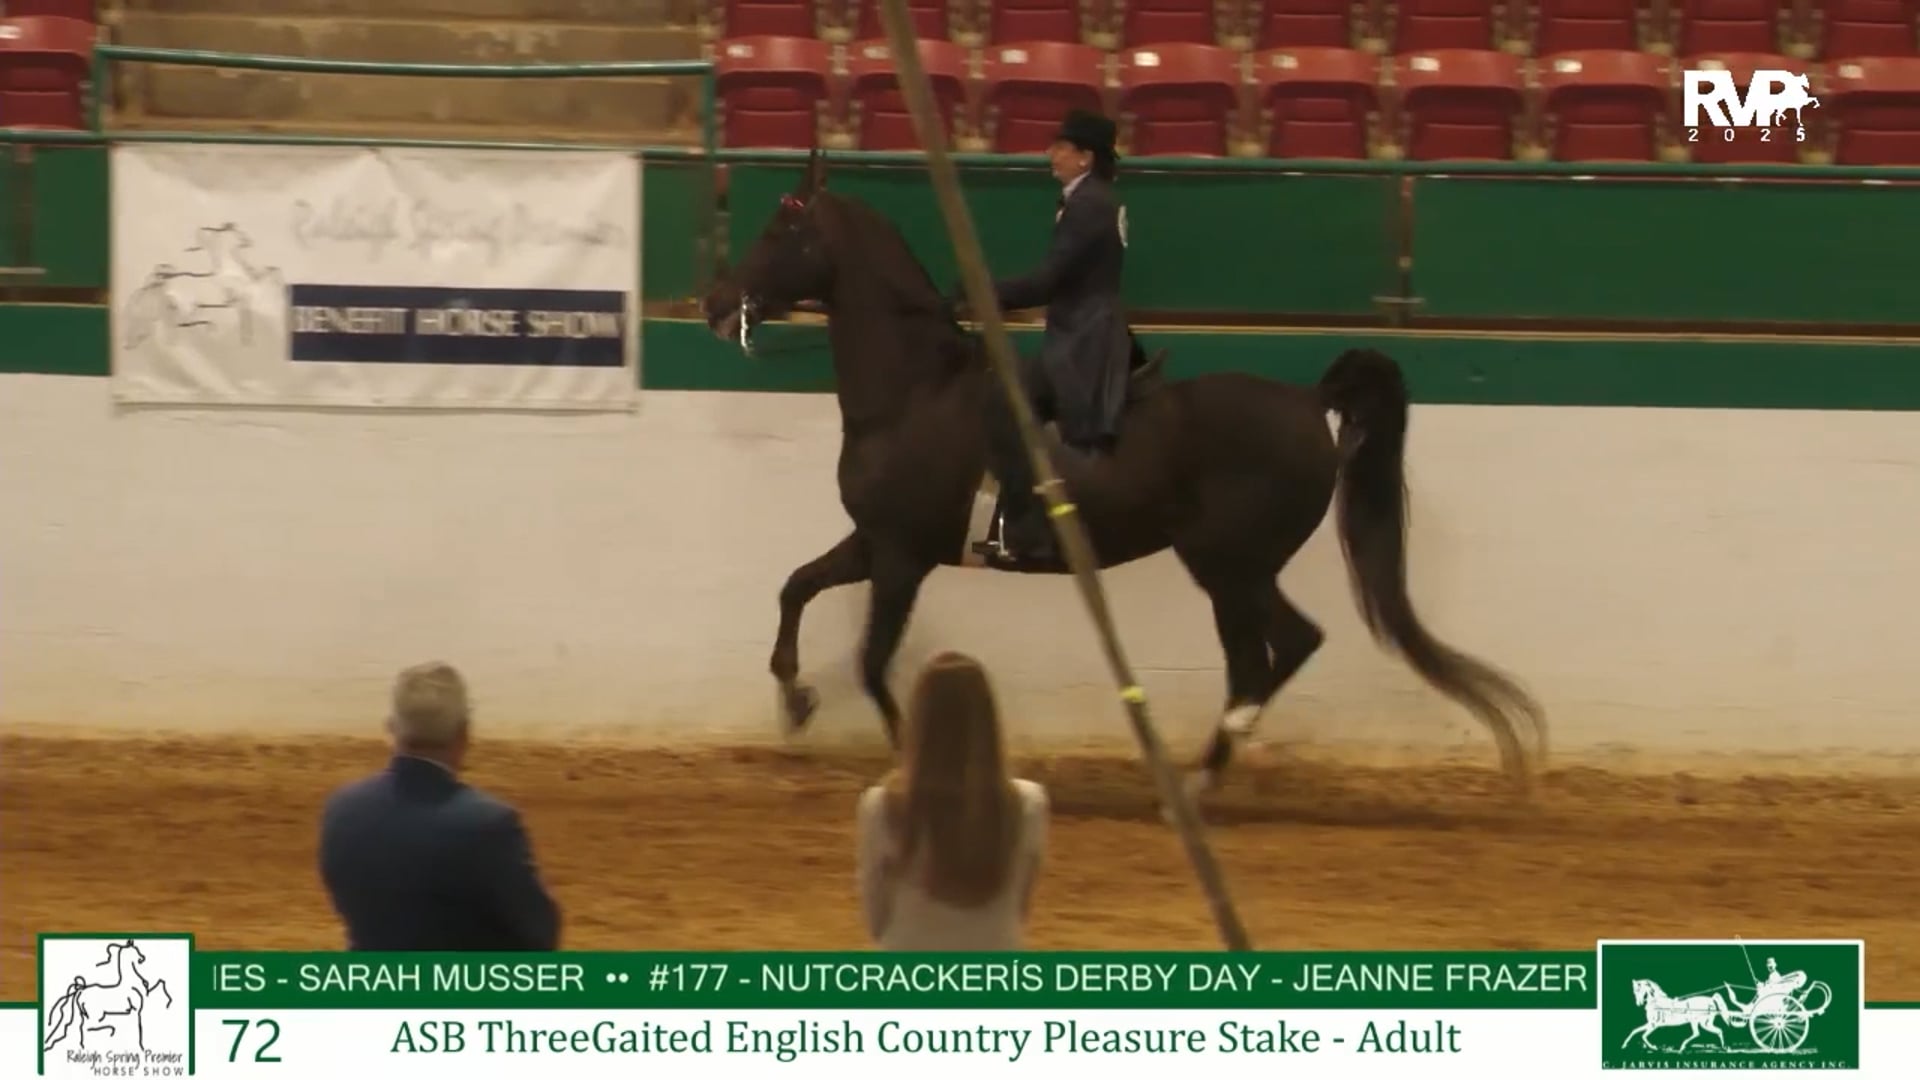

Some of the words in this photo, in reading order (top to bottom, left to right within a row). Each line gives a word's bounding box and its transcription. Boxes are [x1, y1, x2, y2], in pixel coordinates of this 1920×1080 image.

[292, 305, 406, 334] BENEFIT
[414, 308, 521, 337] HORSE
[524, 310, 619, 339] SHOW
